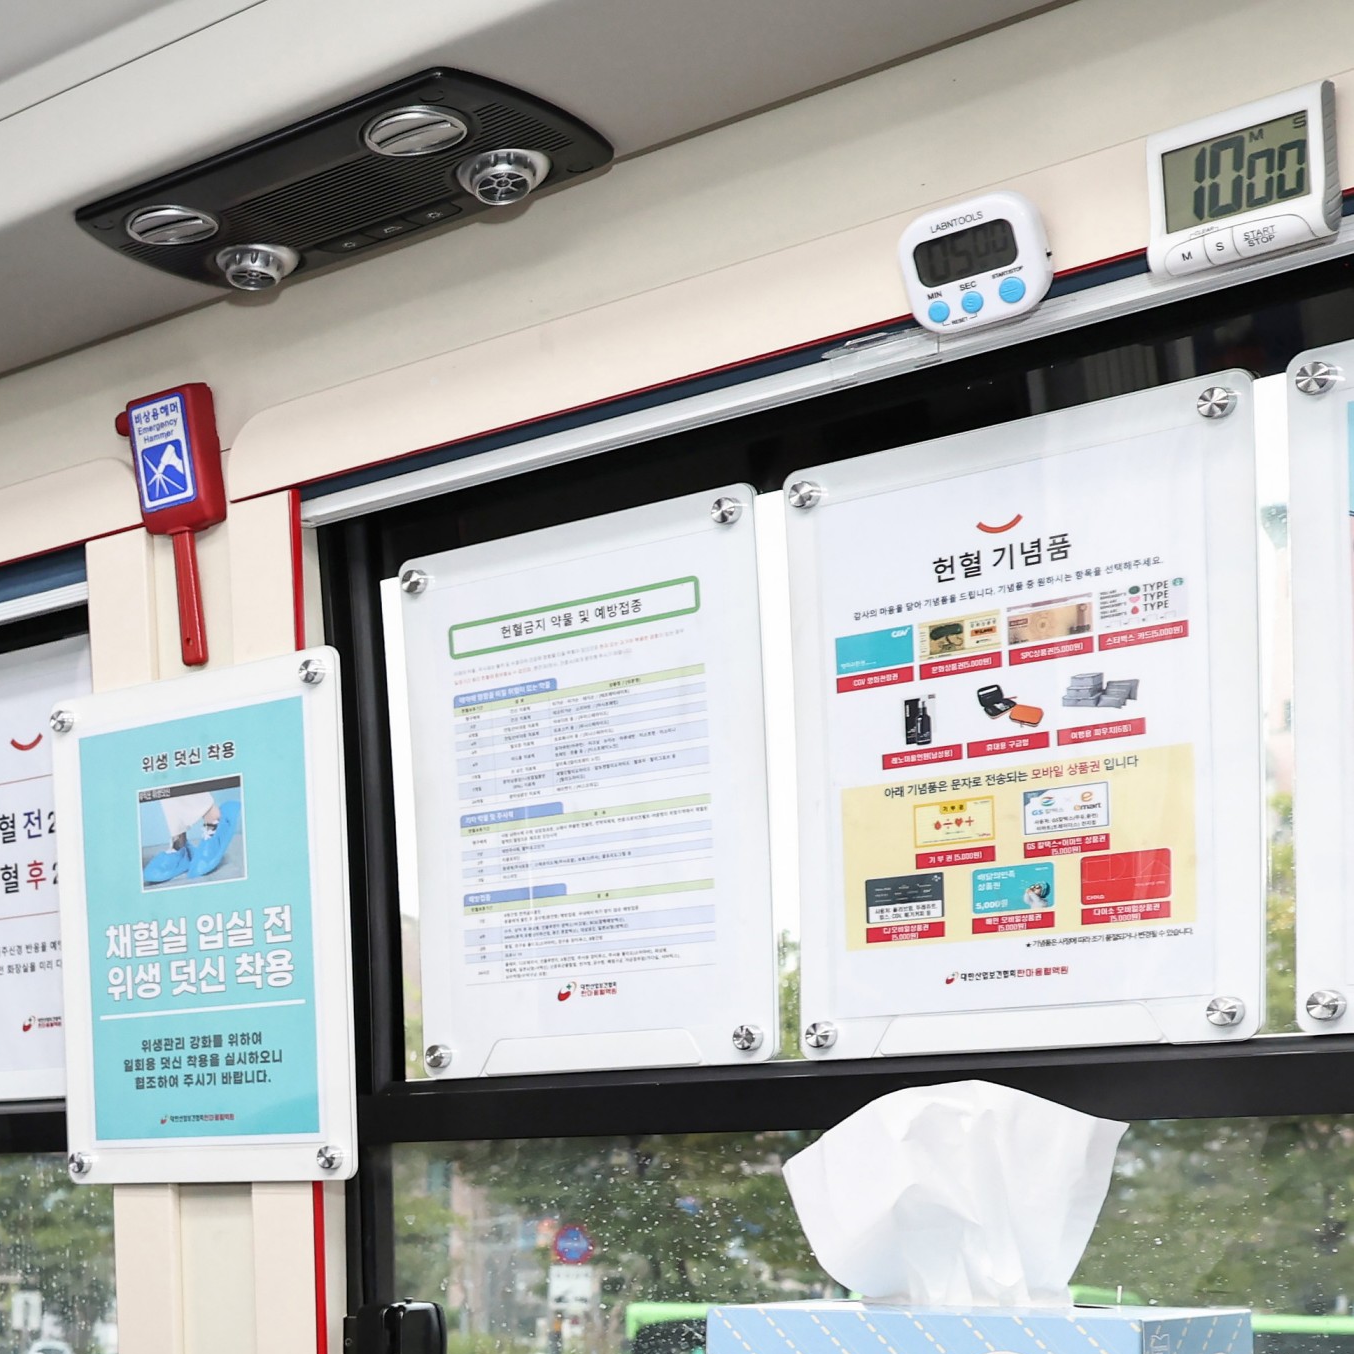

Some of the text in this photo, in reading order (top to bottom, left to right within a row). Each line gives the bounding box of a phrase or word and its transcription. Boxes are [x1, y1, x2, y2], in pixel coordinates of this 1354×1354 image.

[1249, 115, 1307, 143] M S
[930, 211, 984, 234] LABNTOOLS
[1243, 224, 1276, 241] START
[1248, 234, 1276, 247] STOP
[1181, 242, 1225, 262] M S
[927, 291, 942, 301] MIN
[959, 280, 977, 292] SEC
[951, 317, 968, 326] RESET
[137, 417, 178, 436] Emergency
[143, 429, 174, 444] Hammer
[932, 533, 1072, 583] 헌혈 기념품
[853, 608, 878, 621] 감사의
[879, 604, 903, 616] 마음을
[905, 600, 922, 611] 담아
[924, 594, 957, 607] 기념품을
[998, 581, 1024, 594] 기념품
[1026, 580, 1034, 589] 중
[1037, 573, 1072, 587] 원하시는
[1075, 567, 1102, 580] 항목을
[1143, 580, 1169, 593] TYPE
[1143, 590, 1169, 602] TYPE
[1143, 600, 1169, 612] TYPE
[500, 598, 643, 639] 헌혈금지 약물 및 예방접종
[1105, 634, 1135, 646] 스타벅스
[1070, 729, 1092, 740] 여행용
[142, 741, 235, 772] 위생 덧신 착용
[884, 755, 1139, 799] 아래 기념품은 문자로 전송되는 모바일 상품권 입니다
[1073, 802, 1101, 811] emart
[23, 808, 42, 840] 전
[1026, 843, 1036, 851] GS
[26, 860, 47, 890] 후
[1093, 903, 1161, 916] 다이소 모바일상품권
[105, 904, 292, 959] 채혈실 입실 전
[25, 941, 47, 954] 반응을
[7, 961, 37, 974] 화장실을
[39, 960, 54, 971] 미리
[107, 948, 295, 1001] 위생 덧신 착용
[141, 1031, 262, 1053] 위생관리 강화를 위하여
[123, 1049, 283, 1072] 일회용 덧신 착용을 실시하오니
[135, 1069, 271, 1090] 협조하여 주시기 바랍니다.
